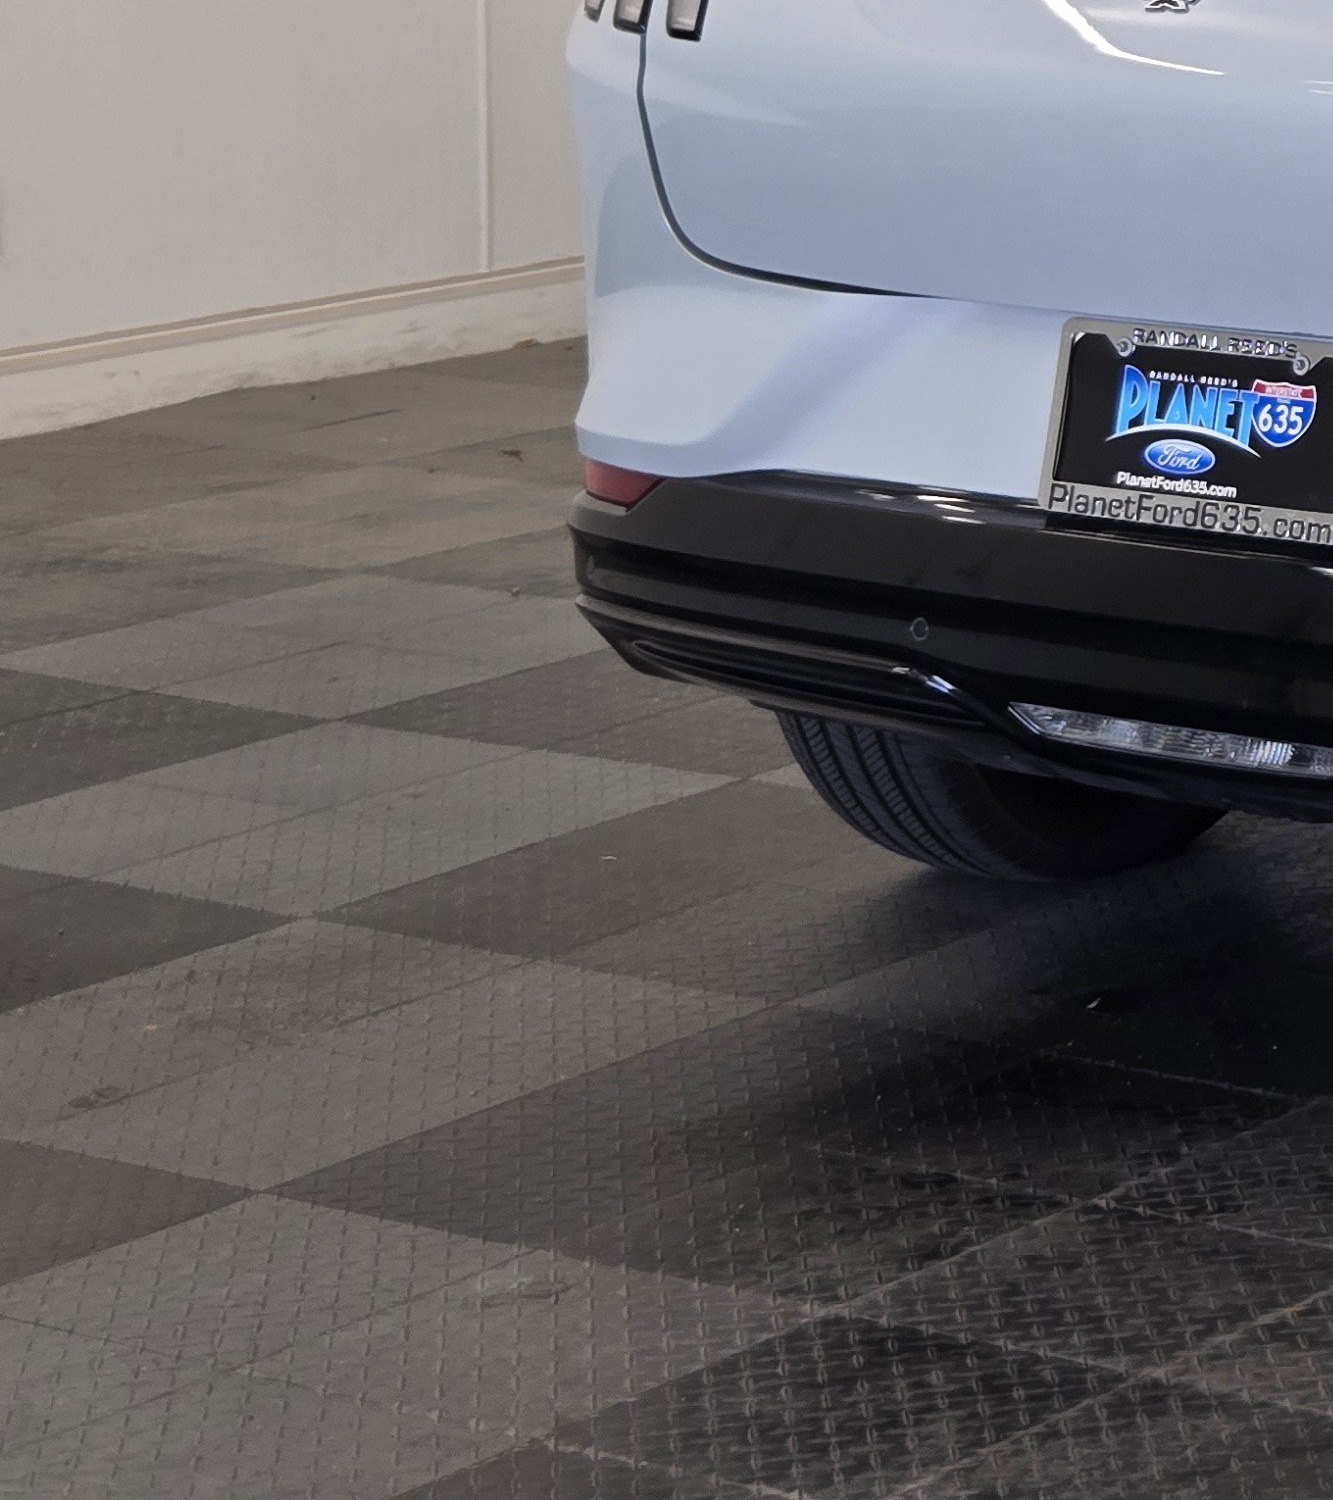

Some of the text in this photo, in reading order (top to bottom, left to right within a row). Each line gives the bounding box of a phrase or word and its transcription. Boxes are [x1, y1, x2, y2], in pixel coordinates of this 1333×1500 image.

[1133, 327, 1221, 350] RANDALL
[1116, 364, 1260, 447] PLANET
[1260, 405, 1304, 435] 635
[1160, 444, 1203, 472] Ford
[1116, 471, 1238, 499] PlanetFord635.com
[1047, 482, 1333, 544] PlanetFord635.com
